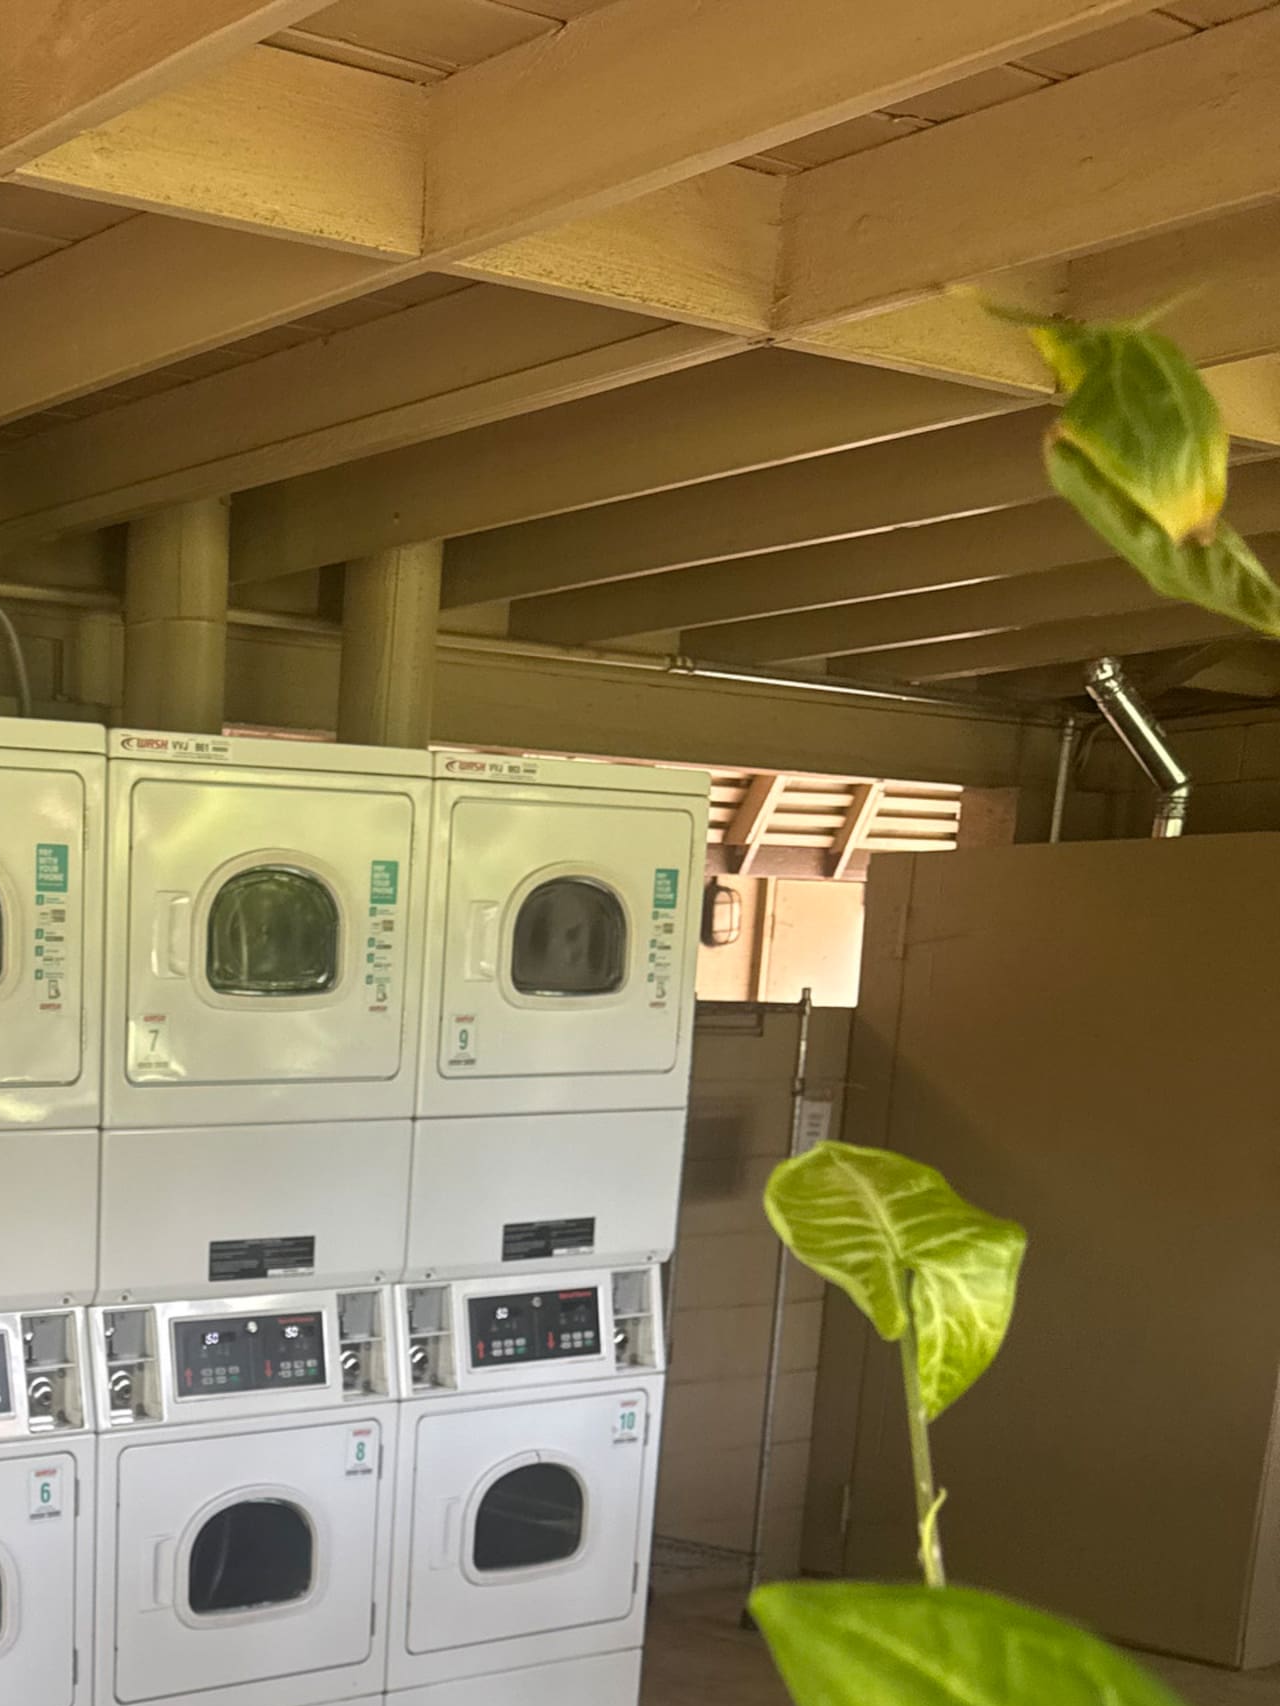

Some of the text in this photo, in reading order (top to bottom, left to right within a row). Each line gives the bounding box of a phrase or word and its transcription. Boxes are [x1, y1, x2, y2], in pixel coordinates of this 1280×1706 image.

[148, 1030, 159, 1051] 7
[459, 1029, 468, 1050] 9
[620, 1411, 636, 1431] 10
[355, 1441, 366, 1461] 8
[40, 1482, 51, 1503] 6
